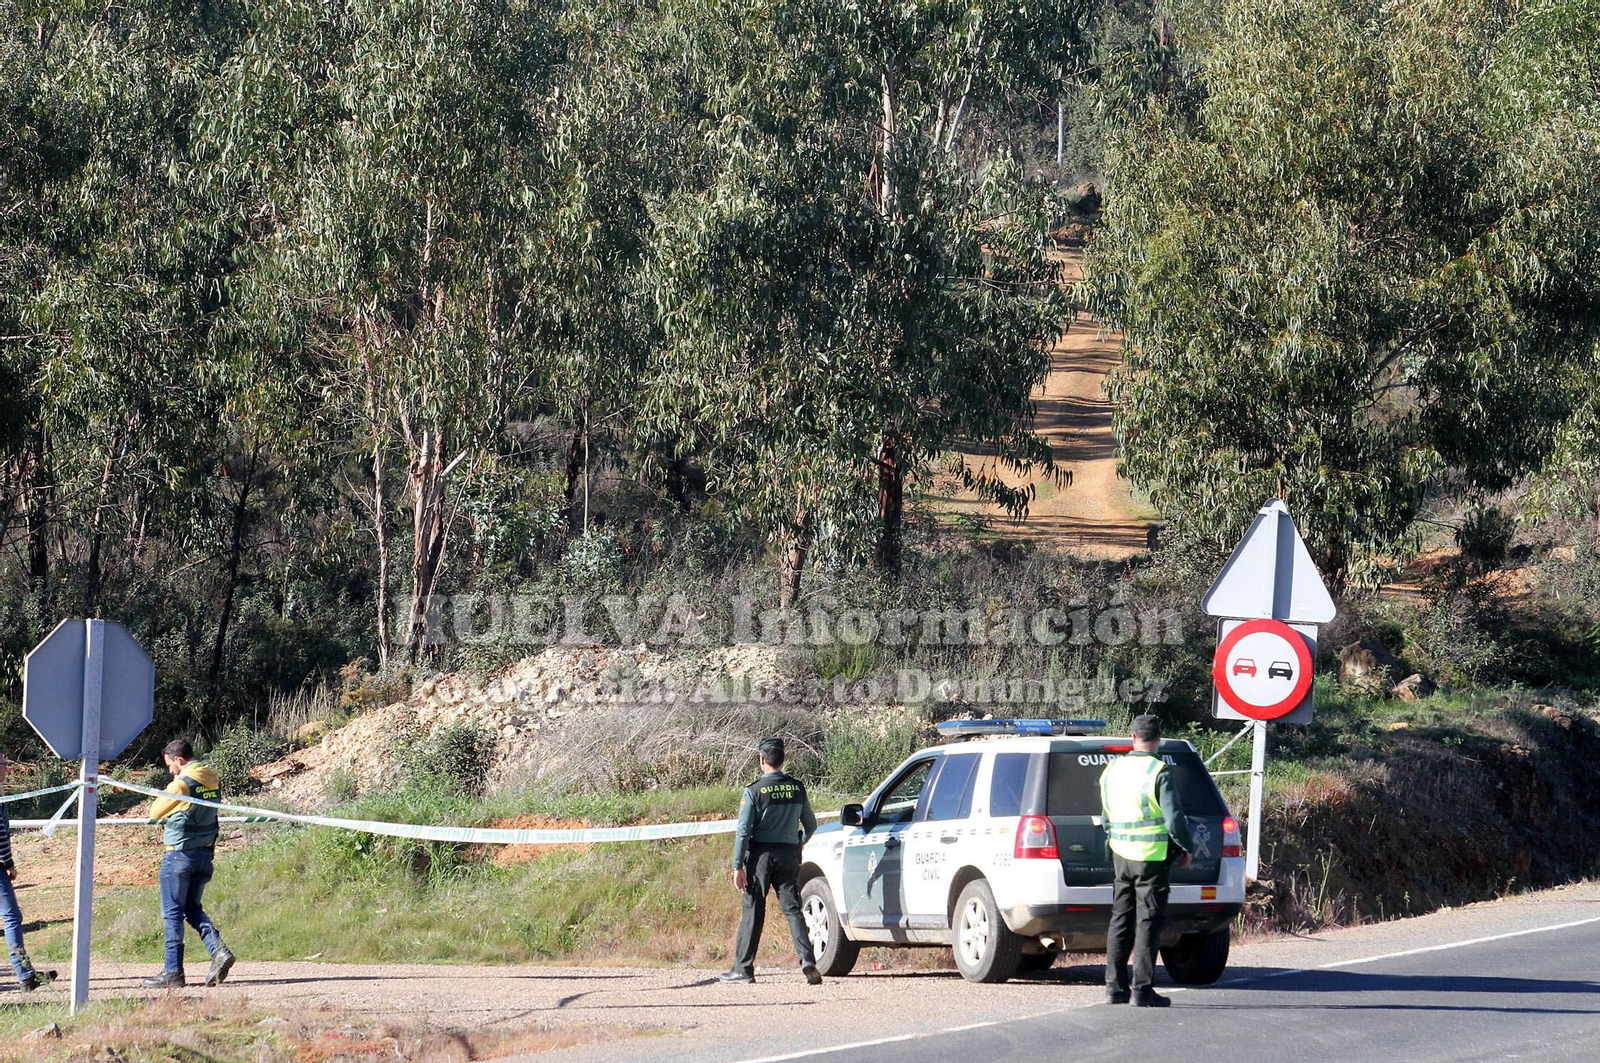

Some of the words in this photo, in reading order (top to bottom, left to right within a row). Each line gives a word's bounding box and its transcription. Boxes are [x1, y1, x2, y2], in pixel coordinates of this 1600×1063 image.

[1077, 754, 1121, 766] GUAR
[760, 784, 800, 794] GUARDIA
[771, 791, 793, 799] CIVIL
[915, 852, 946, 865] GUARDIA
[922, 869, 941, 880] CIVIL
